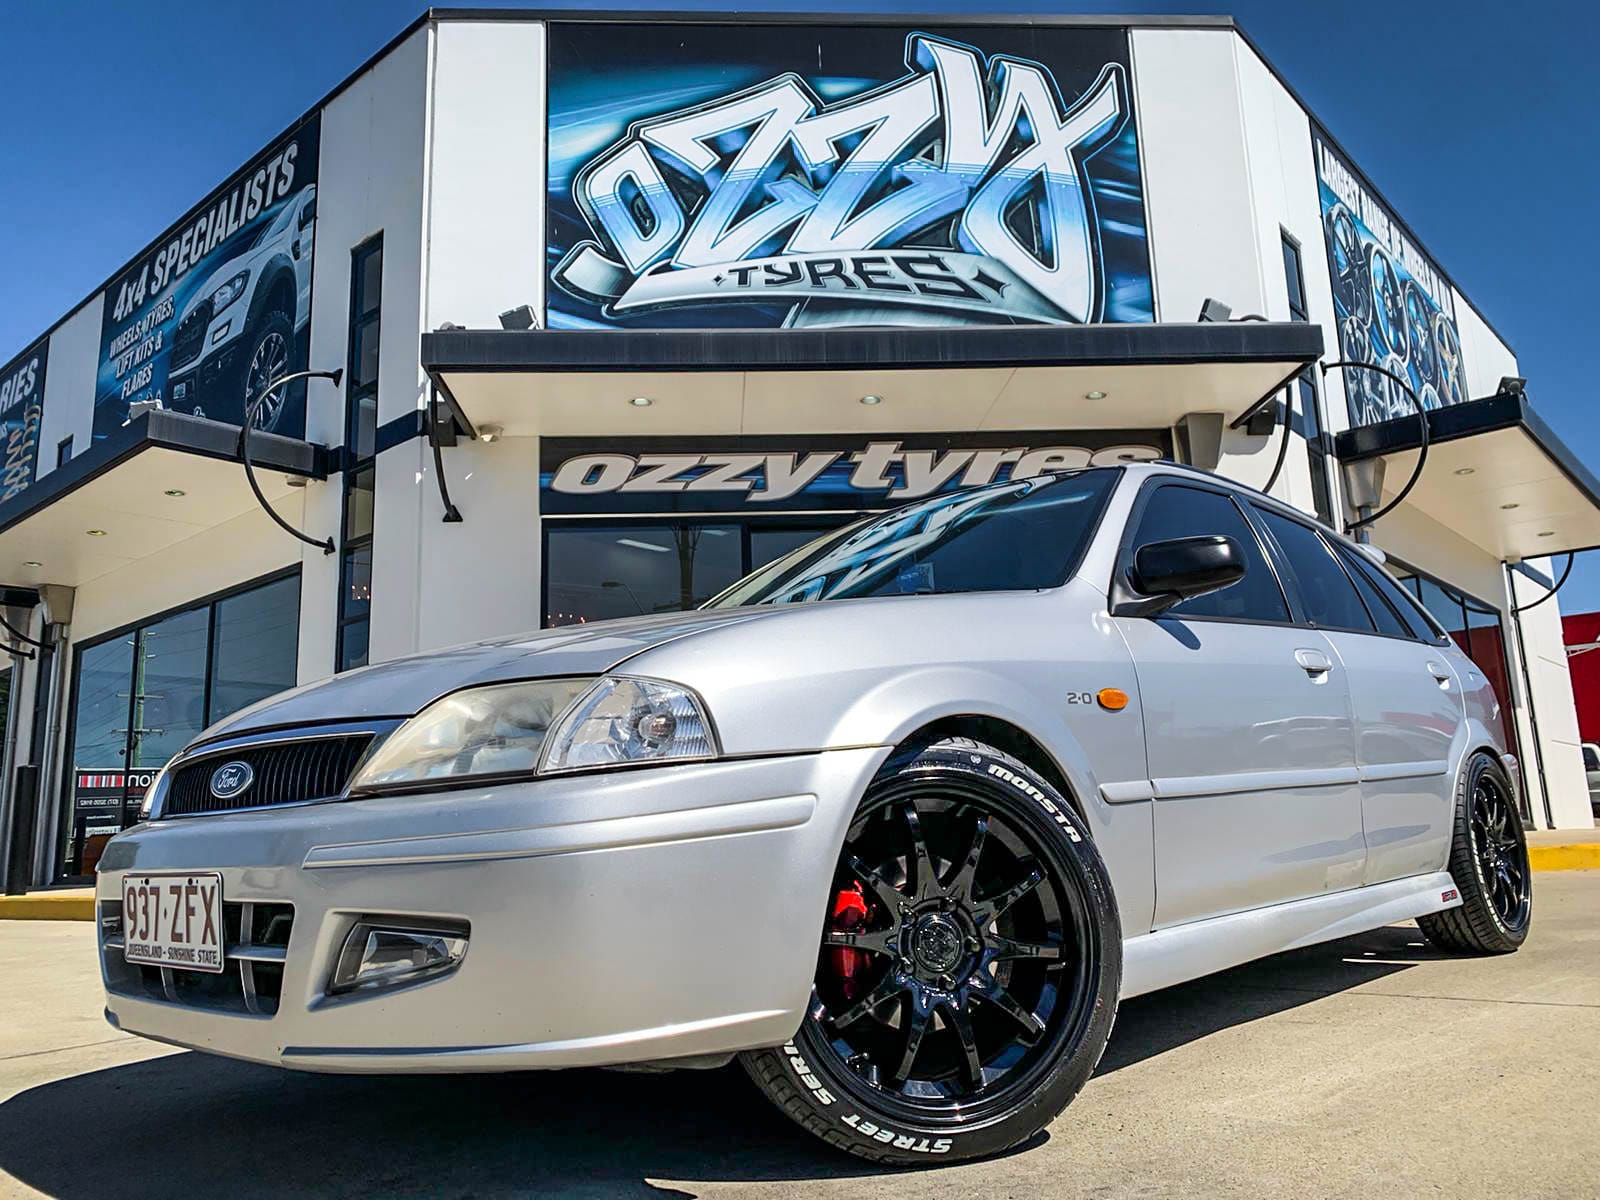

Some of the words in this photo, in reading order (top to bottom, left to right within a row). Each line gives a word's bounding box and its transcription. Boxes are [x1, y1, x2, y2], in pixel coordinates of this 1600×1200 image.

[576, 33, 1127, 322] OZZY
[1316, 137, 1361, 221] LARGEST
[150, 143, 298, 295] SPECIALISTS
[727, 253, 992, 304] TYRES
[116, 351, 135, 379] LIFT
[134, 335, 154, 366] KITS
[121, 362, 153, 400] FLARES
[550, 451, 846, 502] ozzy
[168, 946, 195, 962] SUNSHINE
[198, 949, 217, 965] STATE
[783, 1039, 838, 1106] SERI
[840, 1113, 953, 1154] STREET
